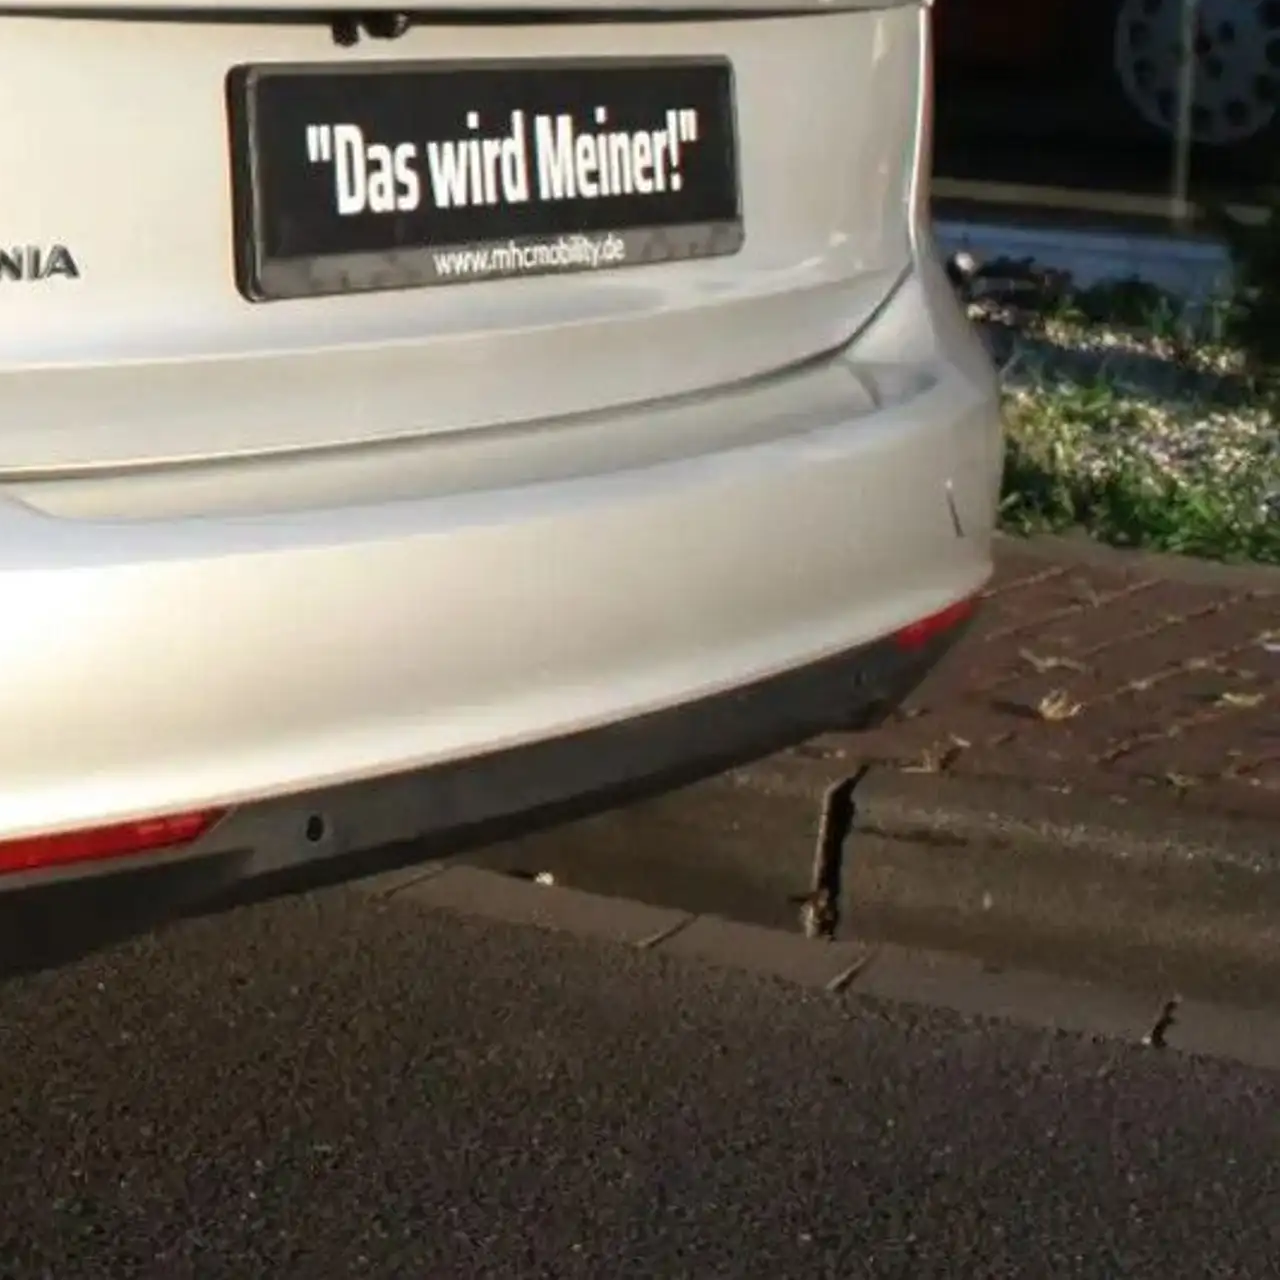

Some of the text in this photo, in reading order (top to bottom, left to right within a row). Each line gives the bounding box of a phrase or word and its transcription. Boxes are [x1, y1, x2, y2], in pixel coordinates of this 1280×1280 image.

[306, 107, 698, 216] "Das wird Meiner!"
[433, 234, 626, 276] www.mhcmobility.de
